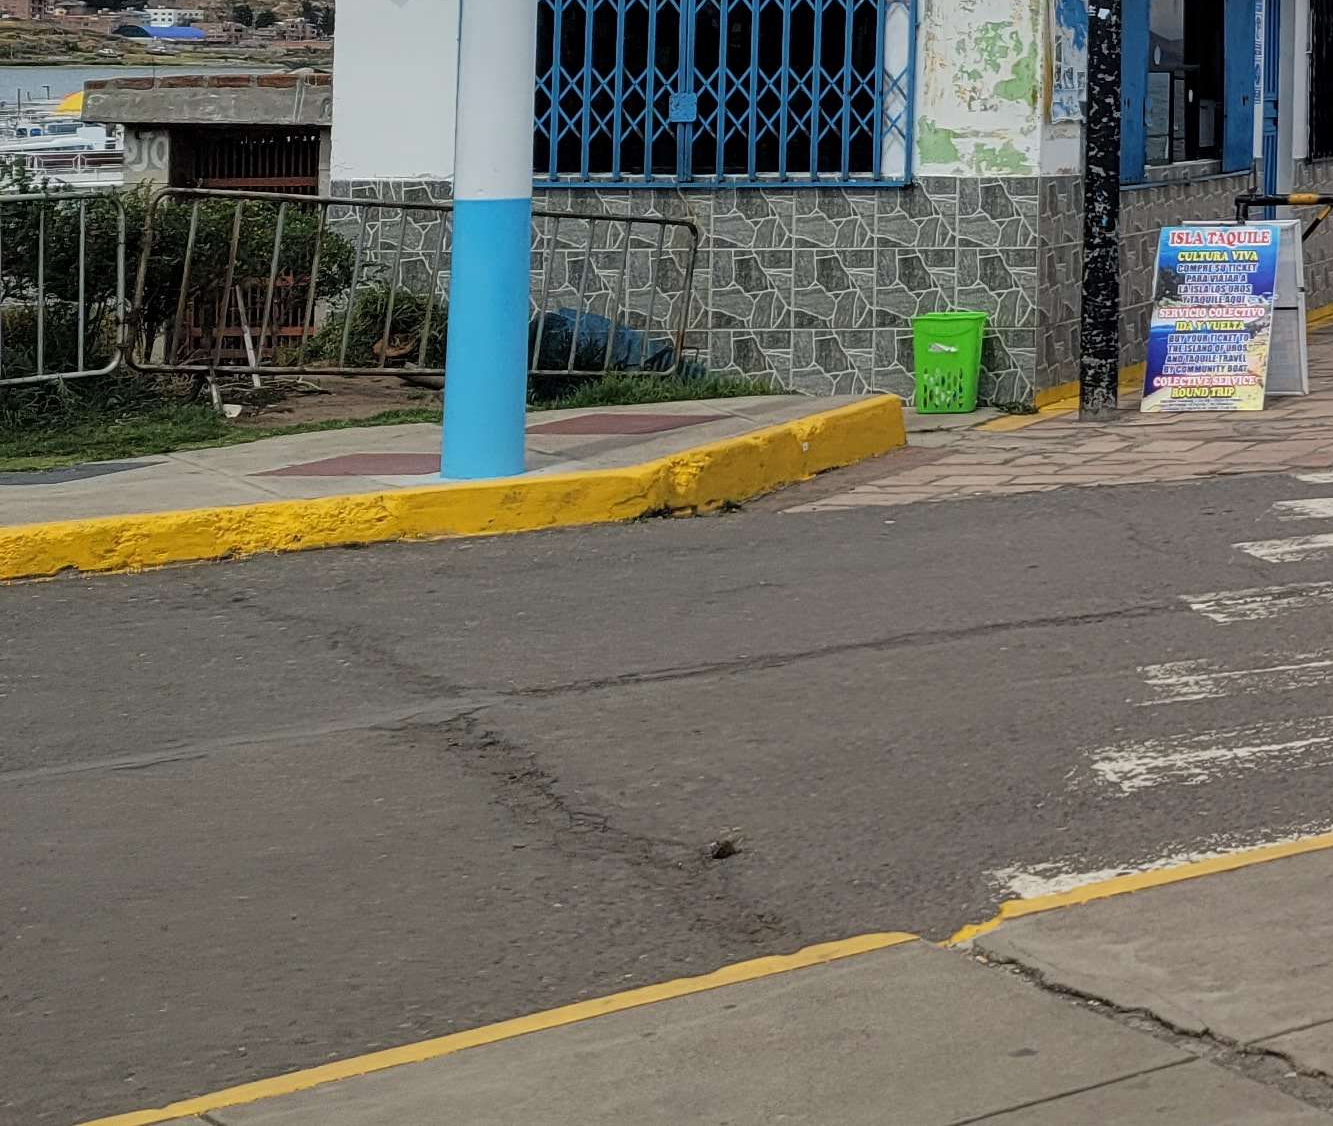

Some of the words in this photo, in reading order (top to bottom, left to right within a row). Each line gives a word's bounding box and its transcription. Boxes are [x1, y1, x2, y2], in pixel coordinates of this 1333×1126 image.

[1169, 231, 1203, 245] ISLA
[1207, 231, 1270, 246] TAQUILE
[1178, 251, 1229, 261] CULTURA
[1232, 251, 1259, 261] VIVA
[1177, 263, 1214, 273] COMPRE
[1215, 263, 1227, 272] SU
[1228, 263, 1258, 272] TICKET
[1186, 274, 1209, 283] PARA
[1210, 274, 1239, 283] VIAJAR
[1240, 274, 1247, 283] A
[1178, 285, 1188, 294] LA
[1189, 285, 1209, 293] ISLA
[1211, 285, 1227, 293] LOS
[1228, 285, 1252, 293] UROS
[1190, 295, 1224, 304] TAQUILE
[1225, 295, 1245, 304] AQUI
[1159, 308, 1206, 318] SERVICIO
[1208, 307, 1265, 317] COLECTIVO
[1176, 321, 1192, 331] IDA
[1196, 321, 1204, 330] Y
[1205, 321, 1245, 330] VUELTA
[1168, 334, 1184, 343] BUY
[1186, 334, 1209, 343] YOUR
[1210, 334, 1238, 343] TICKET
[1168, 344, 1184, 352] THE
[1185, 344, 1212, 353] ISLAND
[1214, 344, 1225, 352] OF
[1166, 354, 1182, 363] AND
[1185, 354, 1216, 363] TAQUILE
[1218, 354, 1246, 363] TRAVEL
[1163, 365, 1173, 374] BY
[1174, 365, 1226, 373] COMMUNITY
[1227, 365, 1248, 373] BOAT
[1153, 376, 1210, 386] COLECTIVE
[1211, 376, 1257, 385] SERVICE
[1171, 388, 1209, 398] ROUND
[1210, 388, 1235, 397] TRIP
